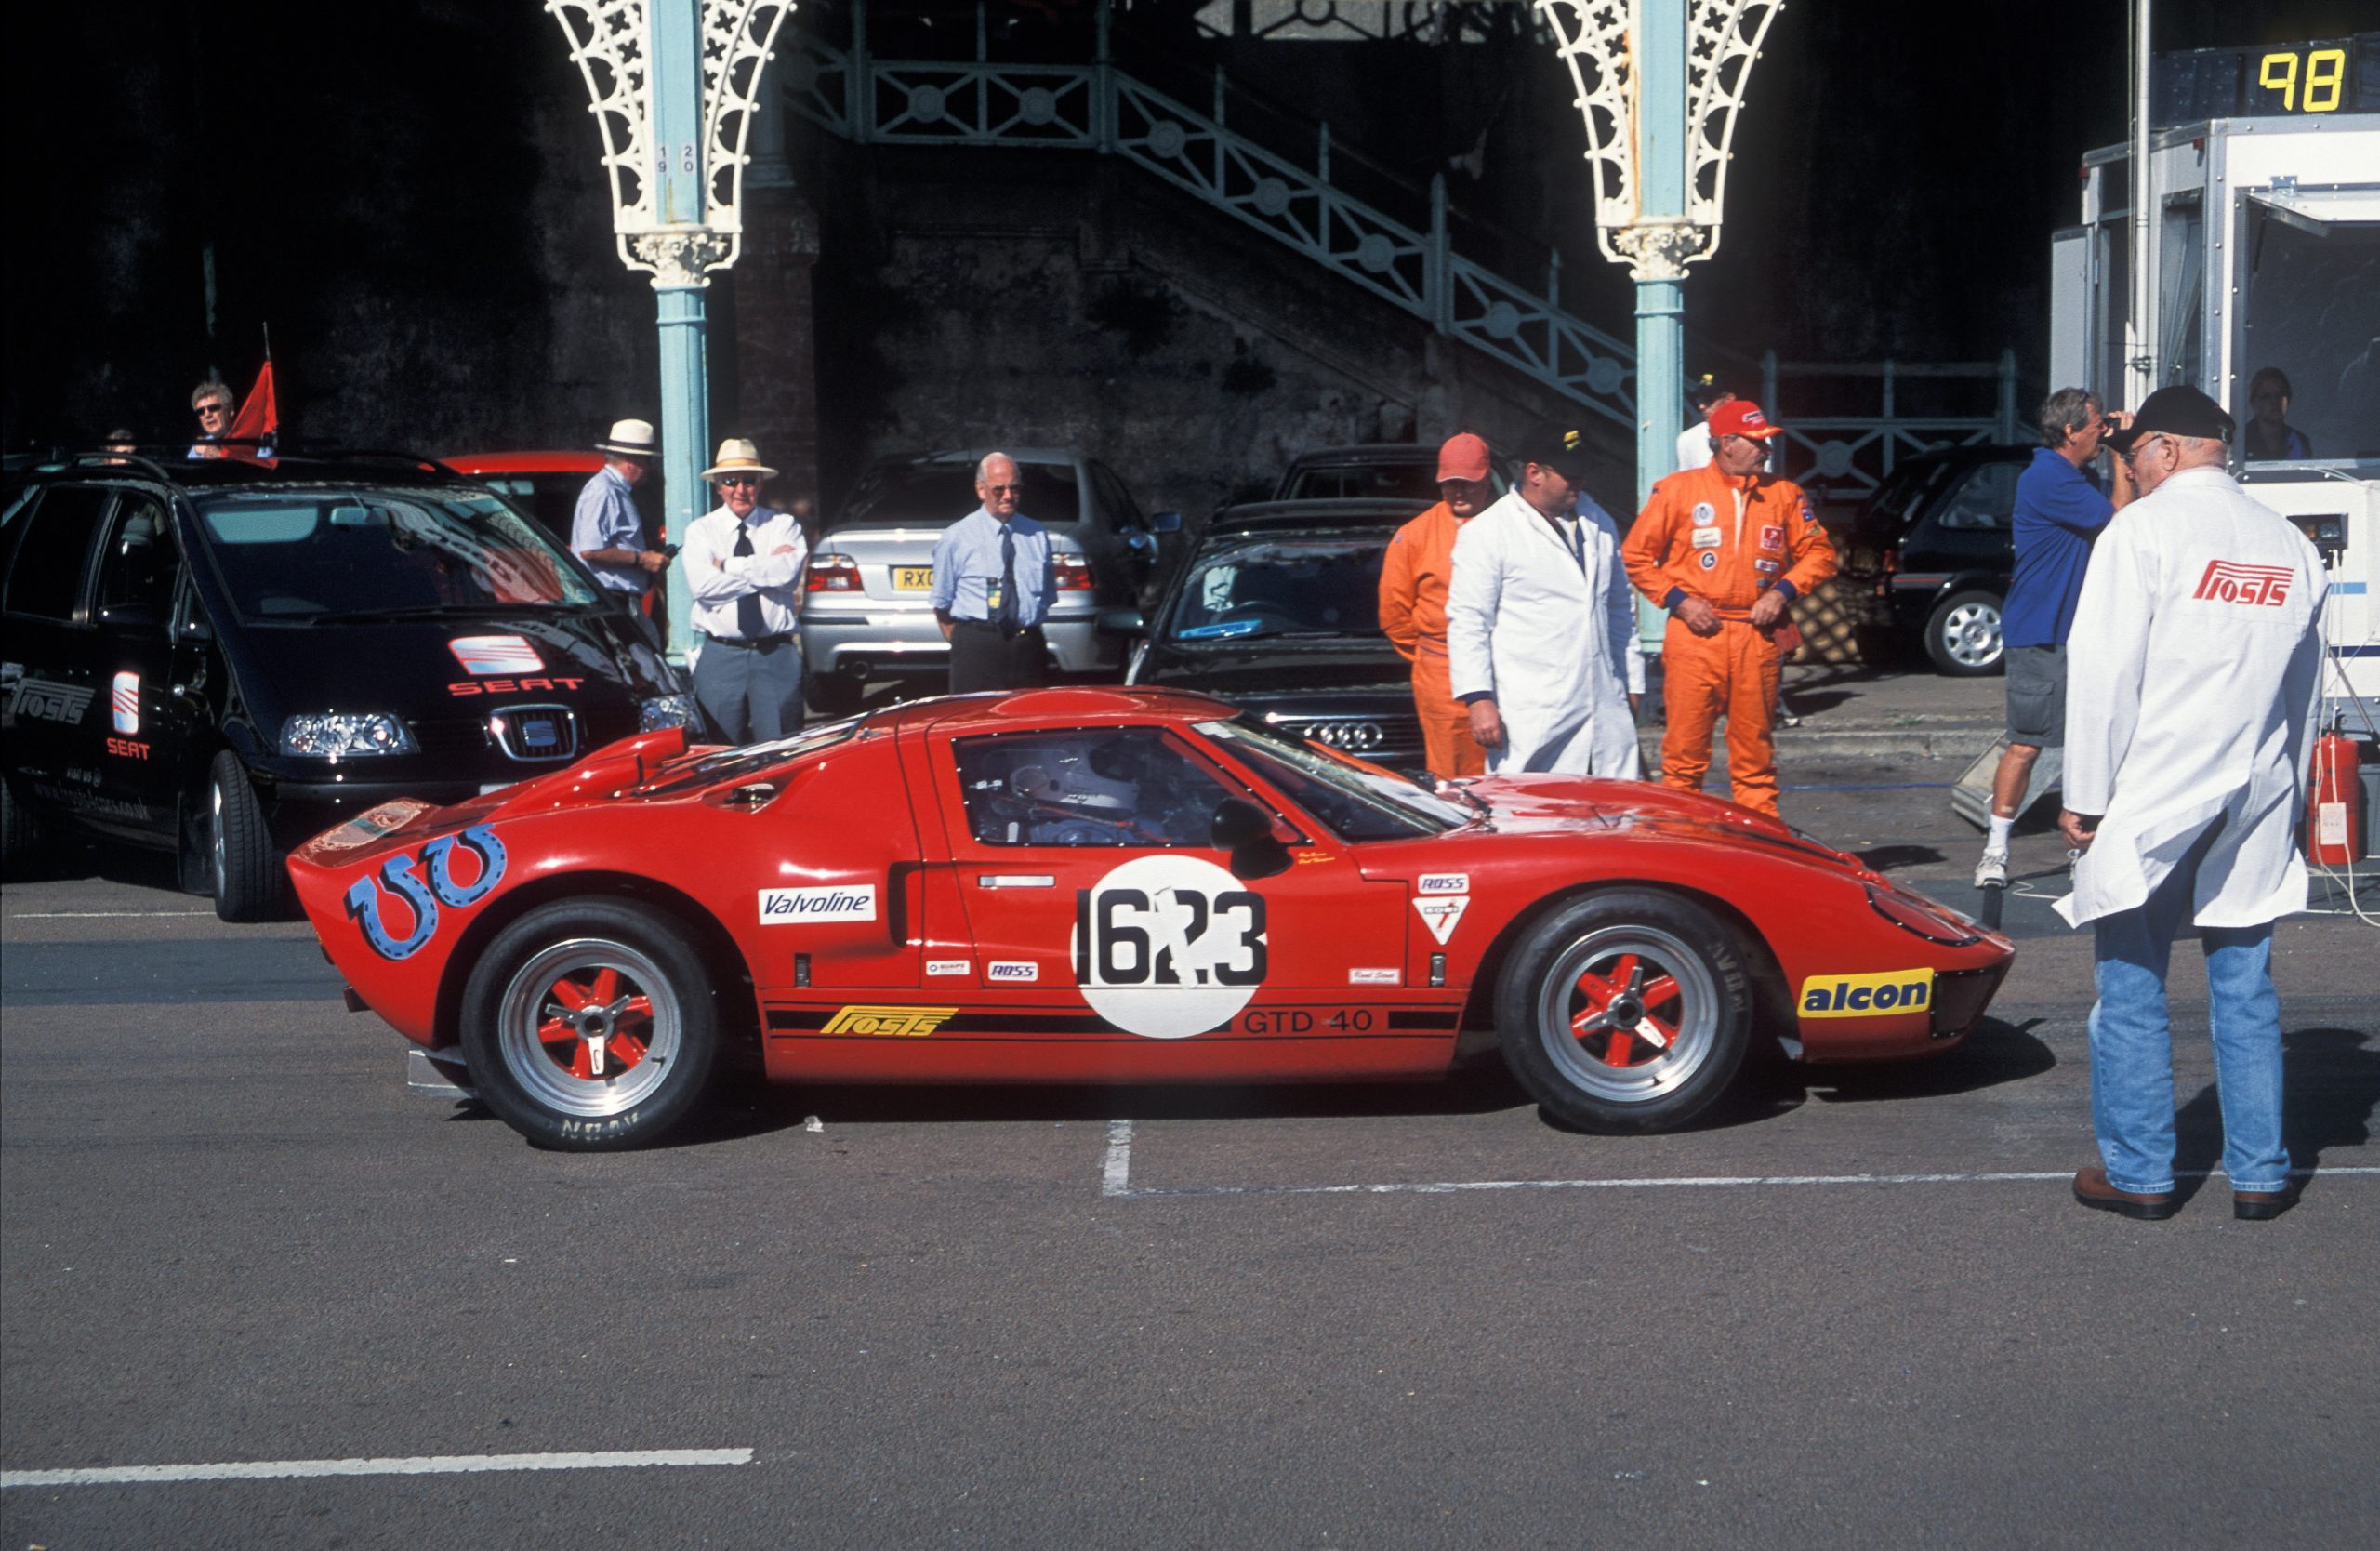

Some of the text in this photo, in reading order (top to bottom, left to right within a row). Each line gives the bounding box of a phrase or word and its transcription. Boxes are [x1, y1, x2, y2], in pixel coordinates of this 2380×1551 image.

[2259, 49, 2346, 112] 98
[2192, 559, 2294, 606] Frosts
[448, 678, 584, 696] SEAT
[106, 737, 150, 760] SEAT
[1421, 878, 1466, 889] ROSS
[764, 892, 870, 915] Valvoline
[991, 965, 1035, 977] ROSS
[1804, 981, 1928, 1012] alcon
[819, 1005, 959, 1037] Frosts
[1244, 1009, 1372, 1034] GTD 40
